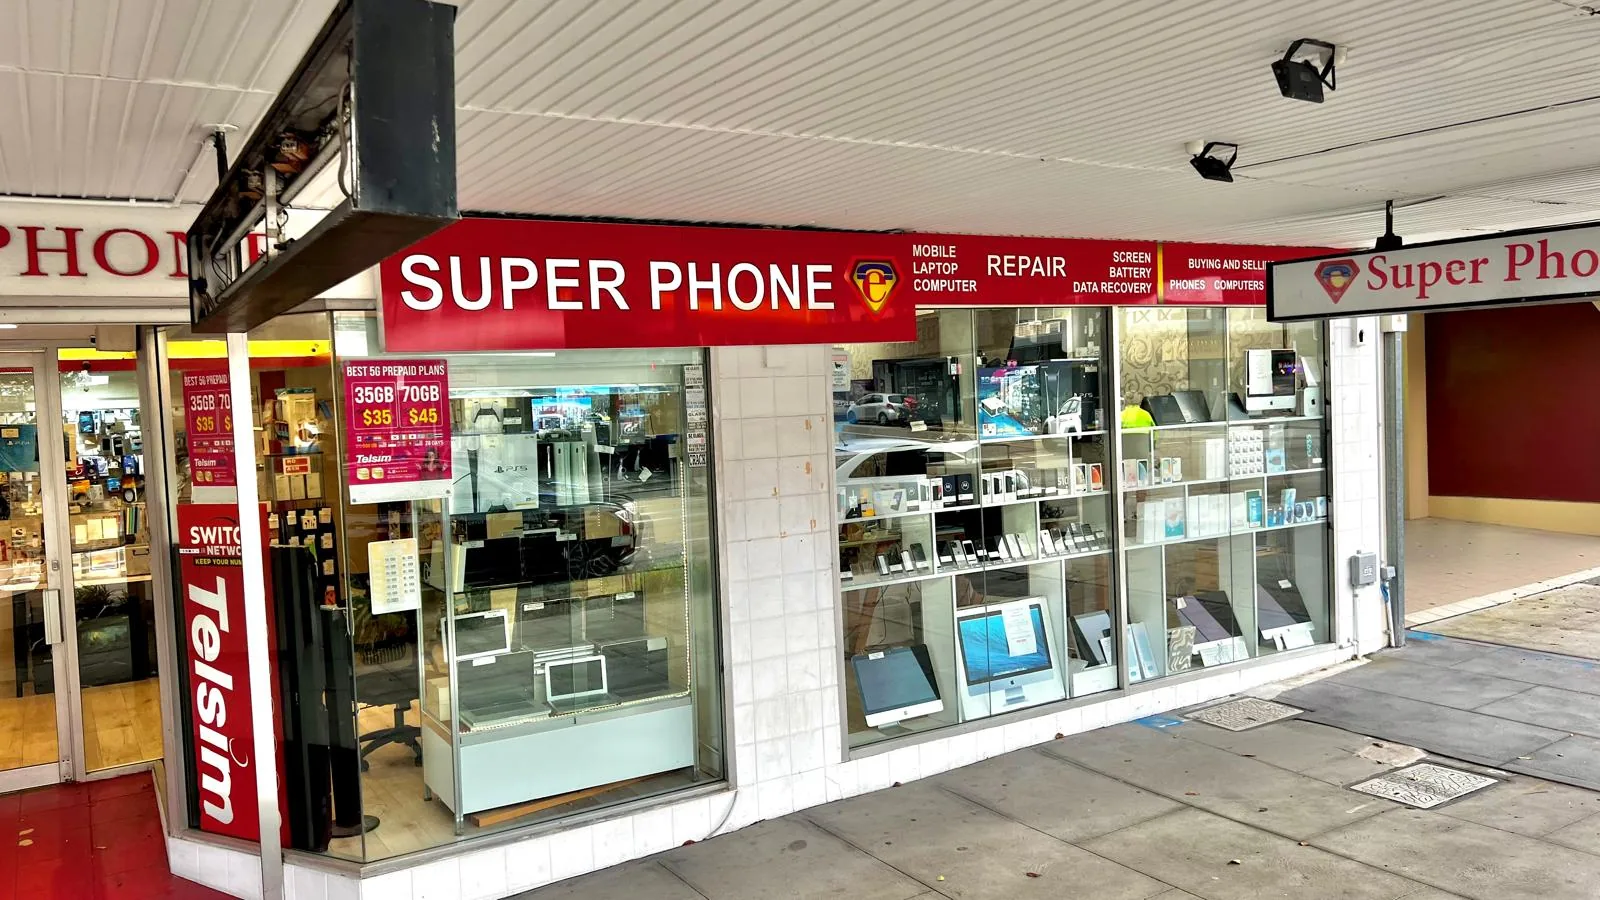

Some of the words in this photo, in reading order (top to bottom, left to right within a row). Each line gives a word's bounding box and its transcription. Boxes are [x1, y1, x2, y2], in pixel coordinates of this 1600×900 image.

[912, 245, 956, 259] MOBILE
[1113, 251, 1151, 263] SCREEN
[913, 262, 958, 275] LAPTOP
[987, 254, 1067, 277] REPAIR
[1188, 258, 1221, 270] BUYING
[1222, 259, 1240, 269] AND
[1242, 260, 1275, 270] SELLI
[1366, 255, 1488, 300] Super
[1503, 239, 1599, 281] Pho
[1109, 266, 1151, 279] BATTERY
[400, 254, 630, 311] SUPER
[649, 260, 835, 311] PHONE
[914, 279, 977, 293] COMPUTER
[1073, 281, 1099, 293] DATA
[1101, 281, 1152, 294] RECOVERY
[1170, 279, 1206, 291] PHONES
[1214, 279, 1264, 291] COMPUTERS
[346, 366, 367, 377] BEST
[382, 366, 417, 377] PREPAID
[419, 365, 445, 376] PLANS
[183, 375, 198, 386] BEST
[206, 374, 228, 385] PREPAID
[354, 386, 394, 404] 35GB
[402, 385, 440, 403] 70GB
[190, 394, 216, 412] 35GB
[363, 408, 392, 426] $35
[409, 407, 438, 425] $45
[196, 415, 214, 432] $35
[194, 458, 217, 468] Telsim
[355, 454, 392, 464] Telsim
[194, 558, 211, 566] KEEP
[212, 558, 229, 566] YOUR
[188, 576, 234, 825] Telsim
